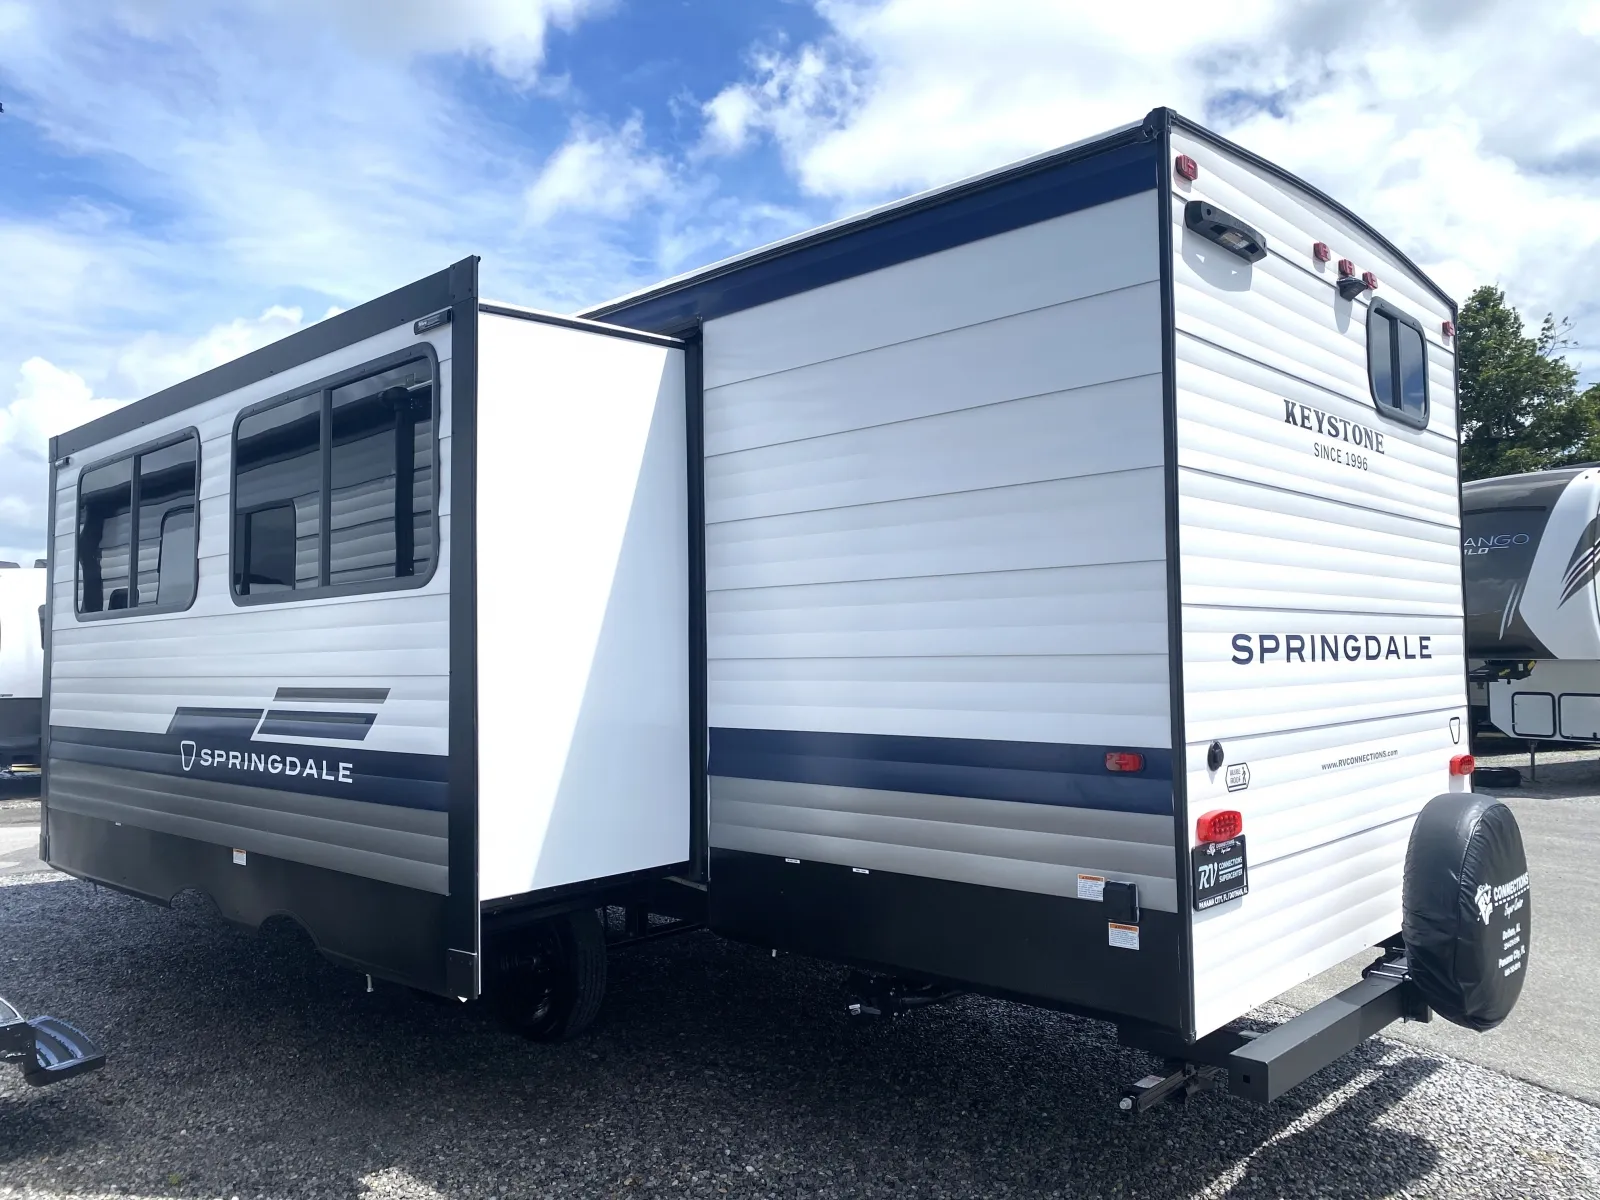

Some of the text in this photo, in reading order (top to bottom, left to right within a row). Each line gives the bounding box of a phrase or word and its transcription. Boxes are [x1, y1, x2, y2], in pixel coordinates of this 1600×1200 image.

[1283, 399, 1385, 455] KEYSTONE
[1313, 442, 1368, 471] SINCE 1996
[1231, 633, 1432, 665] SPRINGDALE
[200, 748, 353, 783] SPRINGDALE
[1321, 749, 1399, 770] www.RVCONNECTIONS.com
[1198, 862, 1218, 890] RV
[1218, 856, 1243, 870] CONNECTIONS
[1493, 871, 1529, 901] CONNECTIONS
